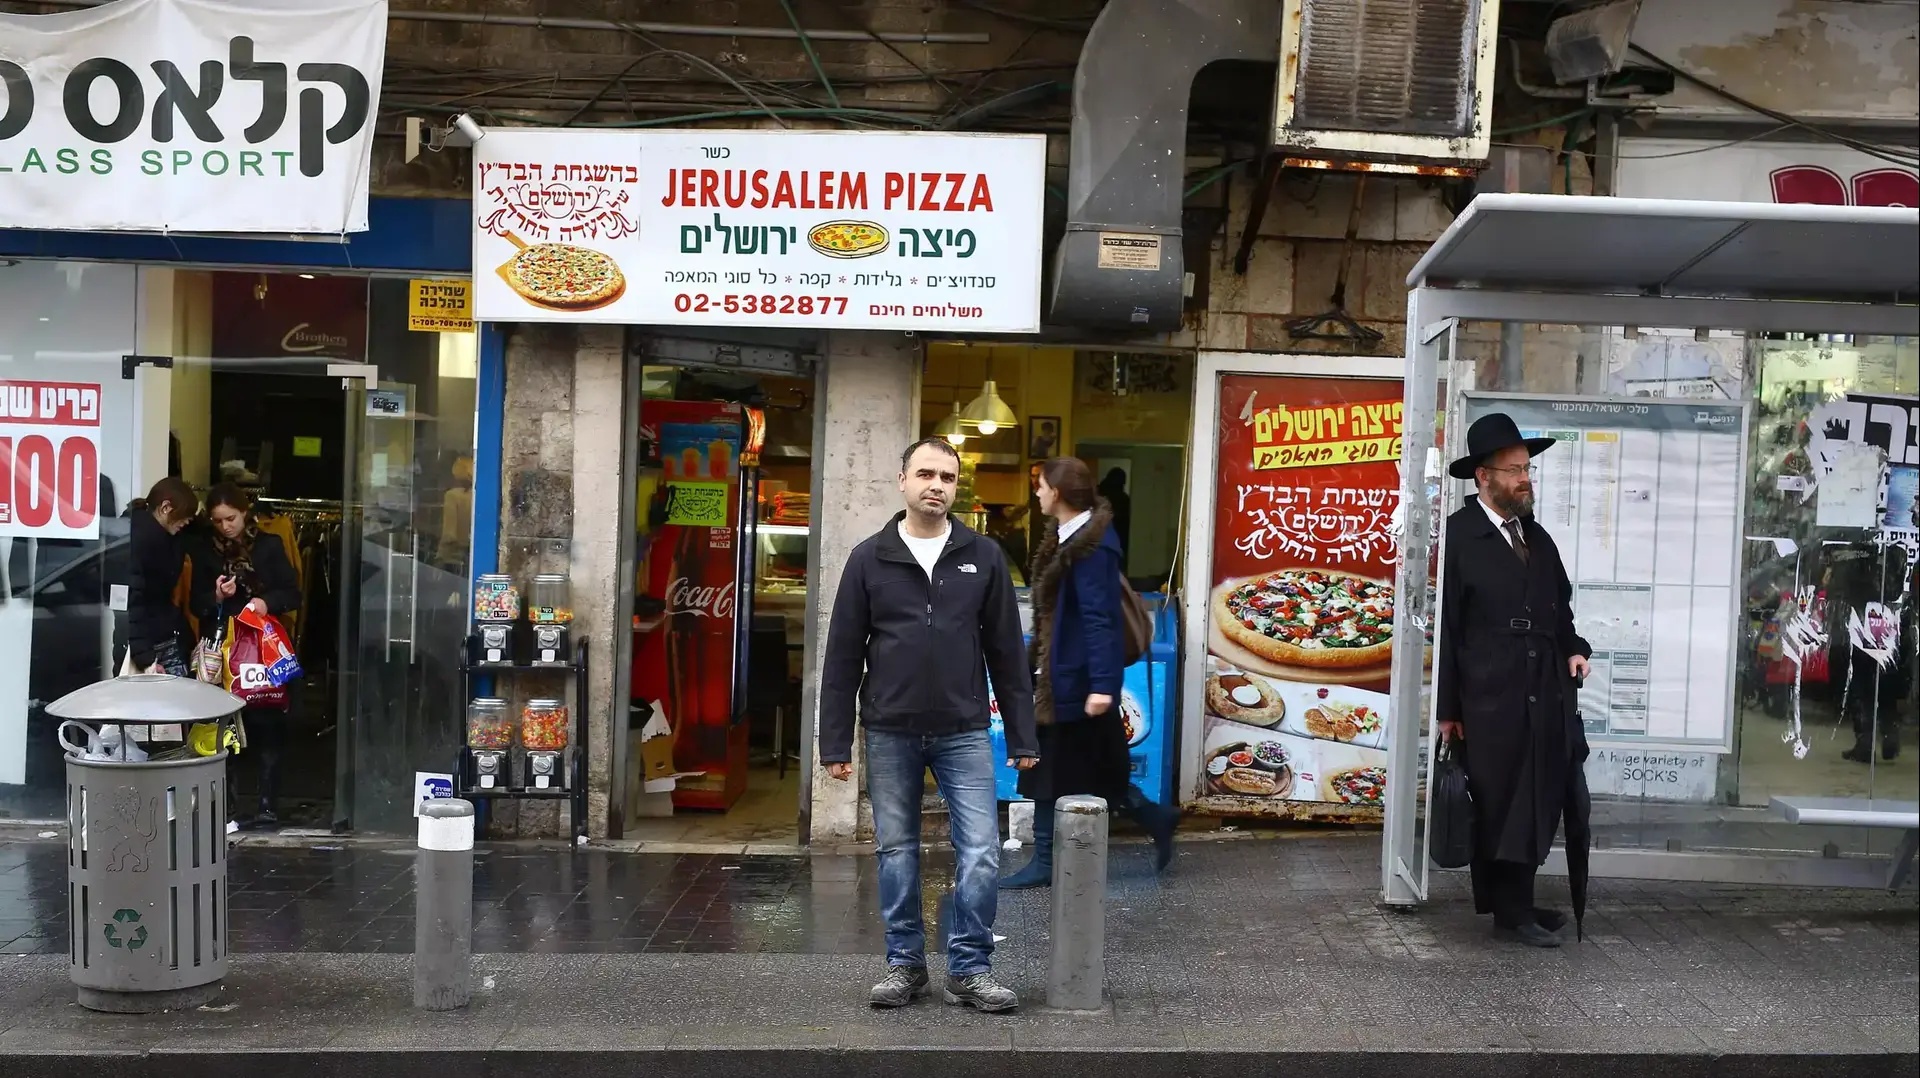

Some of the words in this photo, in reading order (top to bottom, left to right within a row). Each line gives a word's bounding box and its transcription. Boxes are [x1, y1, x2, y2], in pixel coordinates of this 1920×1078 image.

[63, 35, 370, 178] קלאס
[700, 146, 731, 160] כשר
[141, 149, 295, 177] SPORT
[552, 163, 638, 183] בהשגחת
[661, 168, 868, 210] JERUSALEM
[884, 172, 994, 212] PIZZA
[680, 213, 797, 256] ירושלים
[899, 226, 977, 258] פיצה
[664, 270, 717, 284] המאפה
[724, 270, 751, 285] סוגי
[758, 268, 777, 285] כל
[799, 272, 831, 289] קפה
[853, 269, 903, 287] גלידות
[420, 285, 465, 297] שמירה
[420, 297, 465, 309] כהלכה
[674, 293, 849, 316] 02-5382877
[869, 303, 905, 317] חינם
[912, 302, 983, 318] משלוחים
[40, 386, 98, 420] פריט
[1626, 404, 1649, 414] מלכי
[1255, 403, 1346, 444] ירושלים
[1258, 446, 1333, 470] המאפים
[1343, 442, 1379, 461] סוגי
[1320, 487, 1401, 507] השגחת
[1598, 750, 1605, 760] A
[1643, 754, 1688, 768] variety
[1623, 767, 1678, 783] SOCK'S
